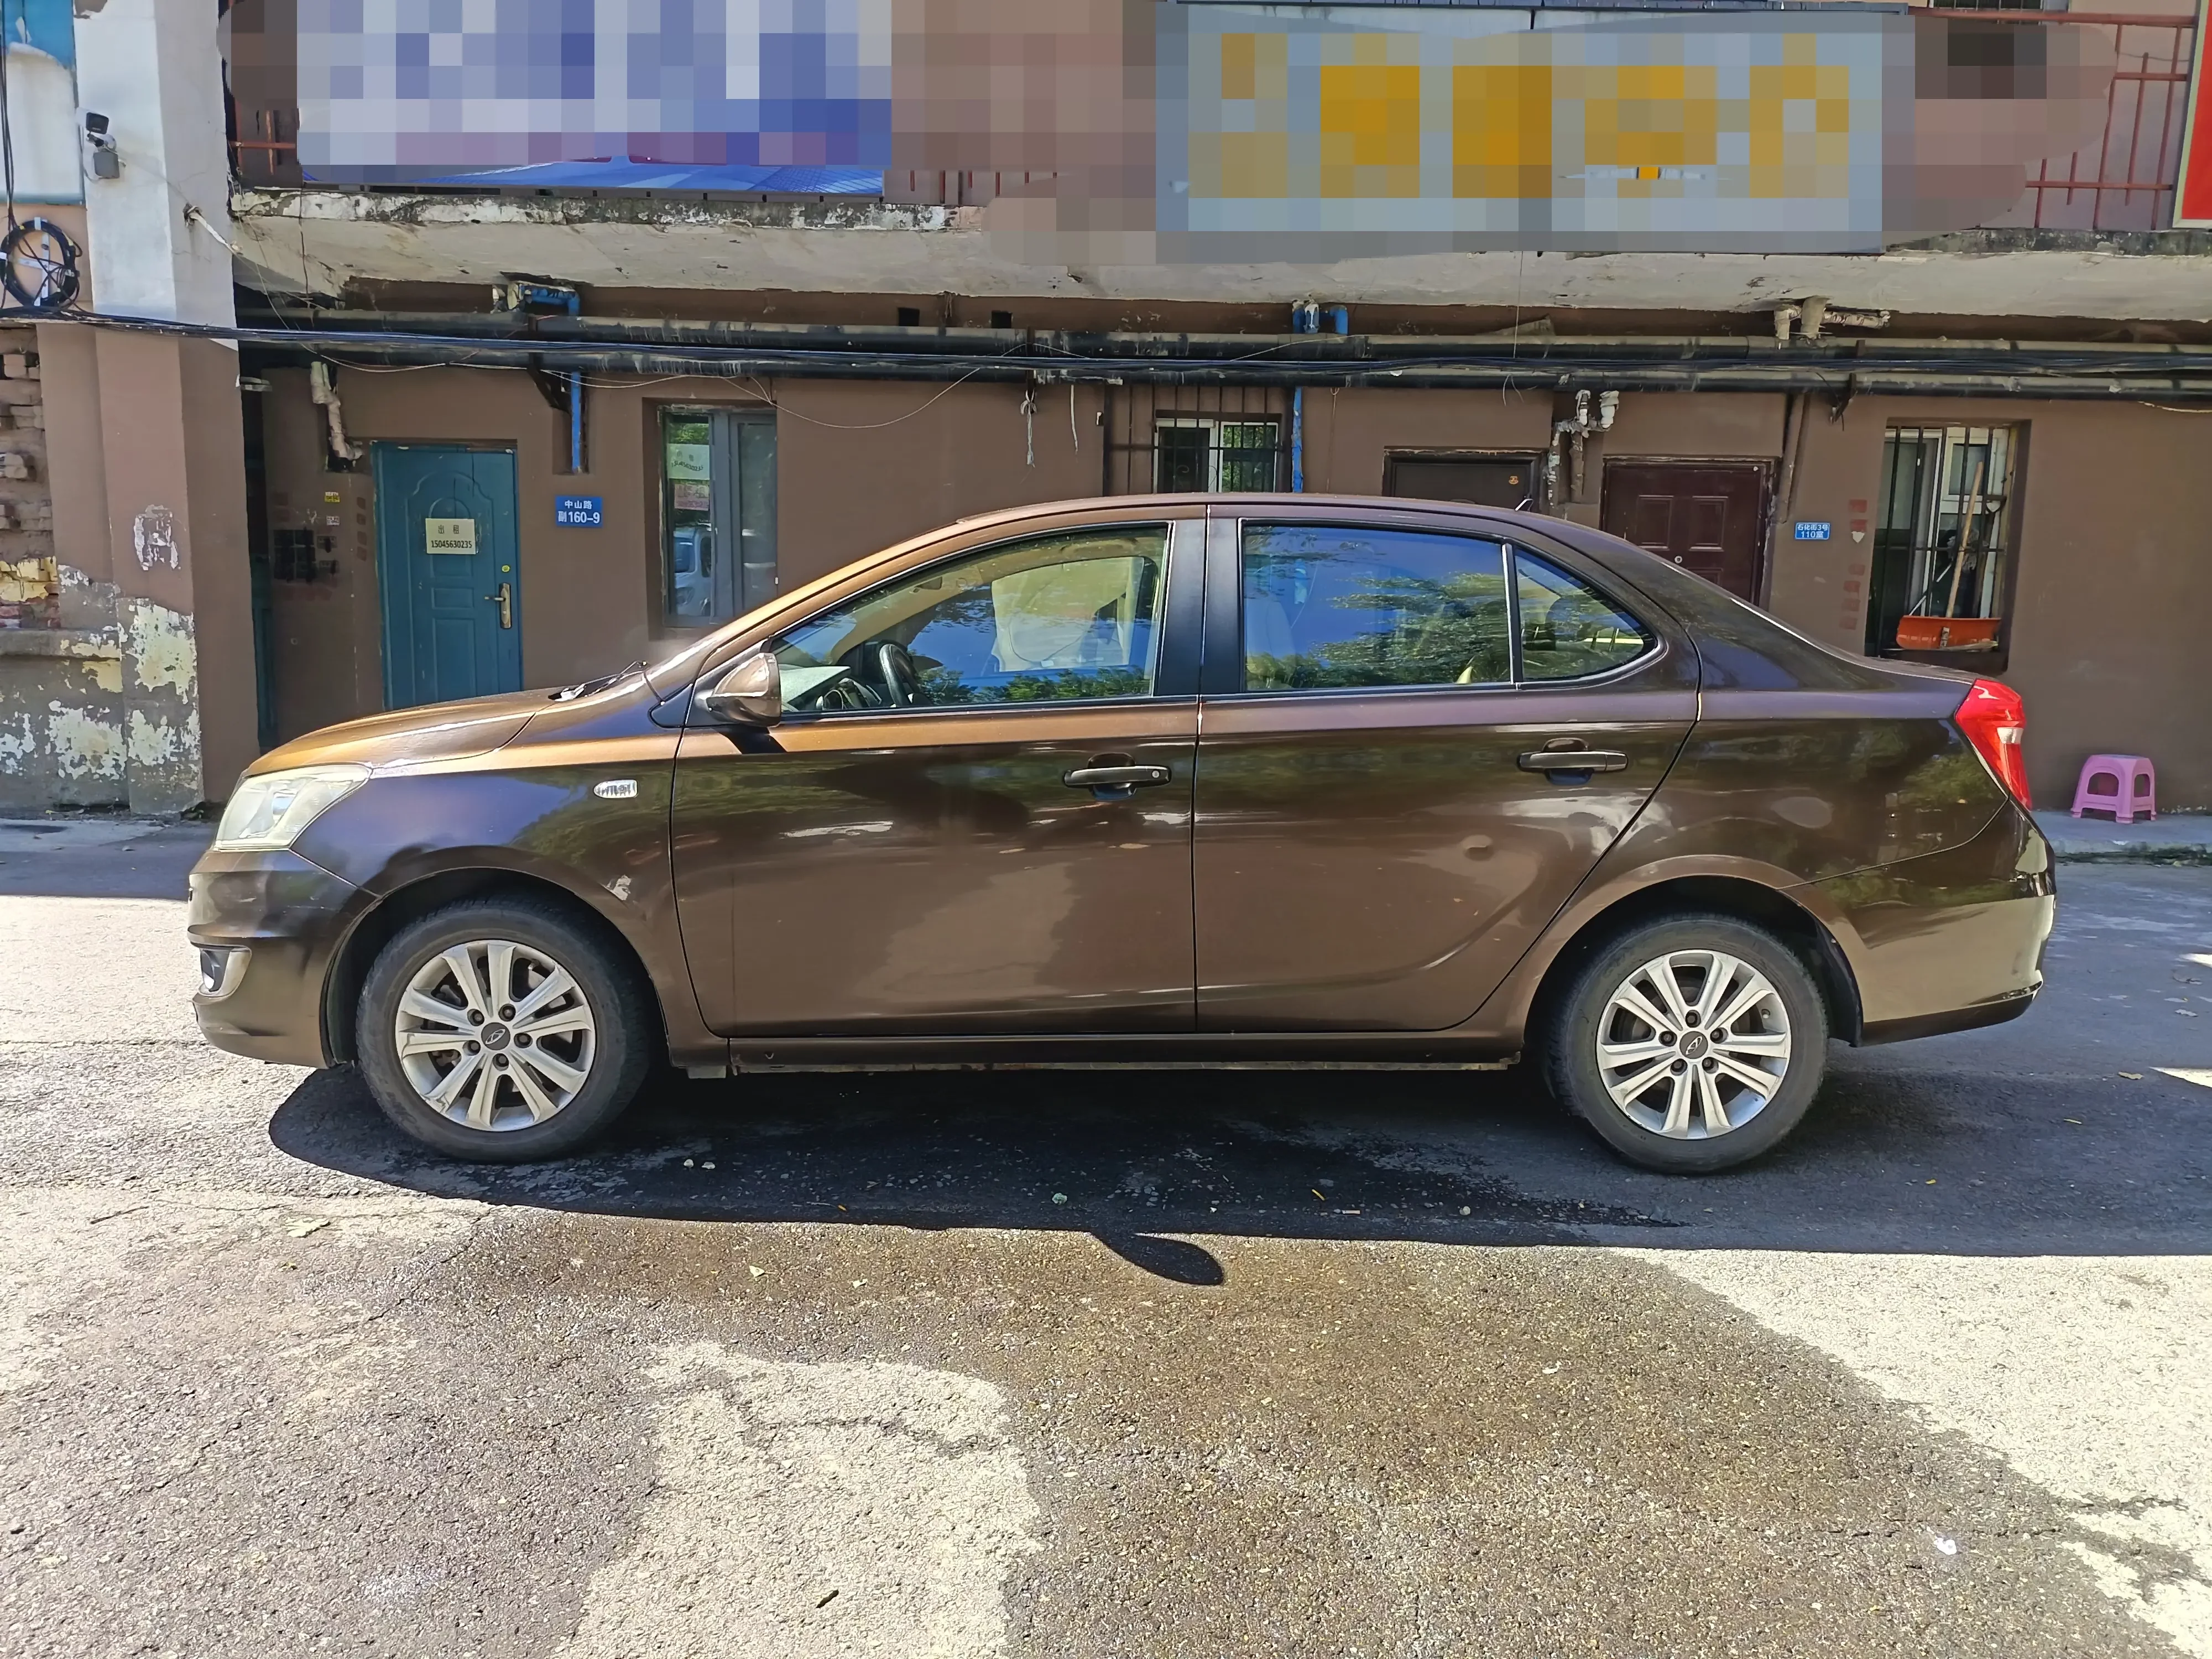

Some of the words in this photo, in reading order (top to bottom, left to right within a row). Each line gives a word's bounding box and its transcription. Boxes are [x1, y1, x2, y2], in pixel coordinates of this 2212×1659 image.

[565, 500, 592, 509] 中山路
[558, 511, 600, 524] 副160-9
[431, 540, 472, 549] 15045630235
